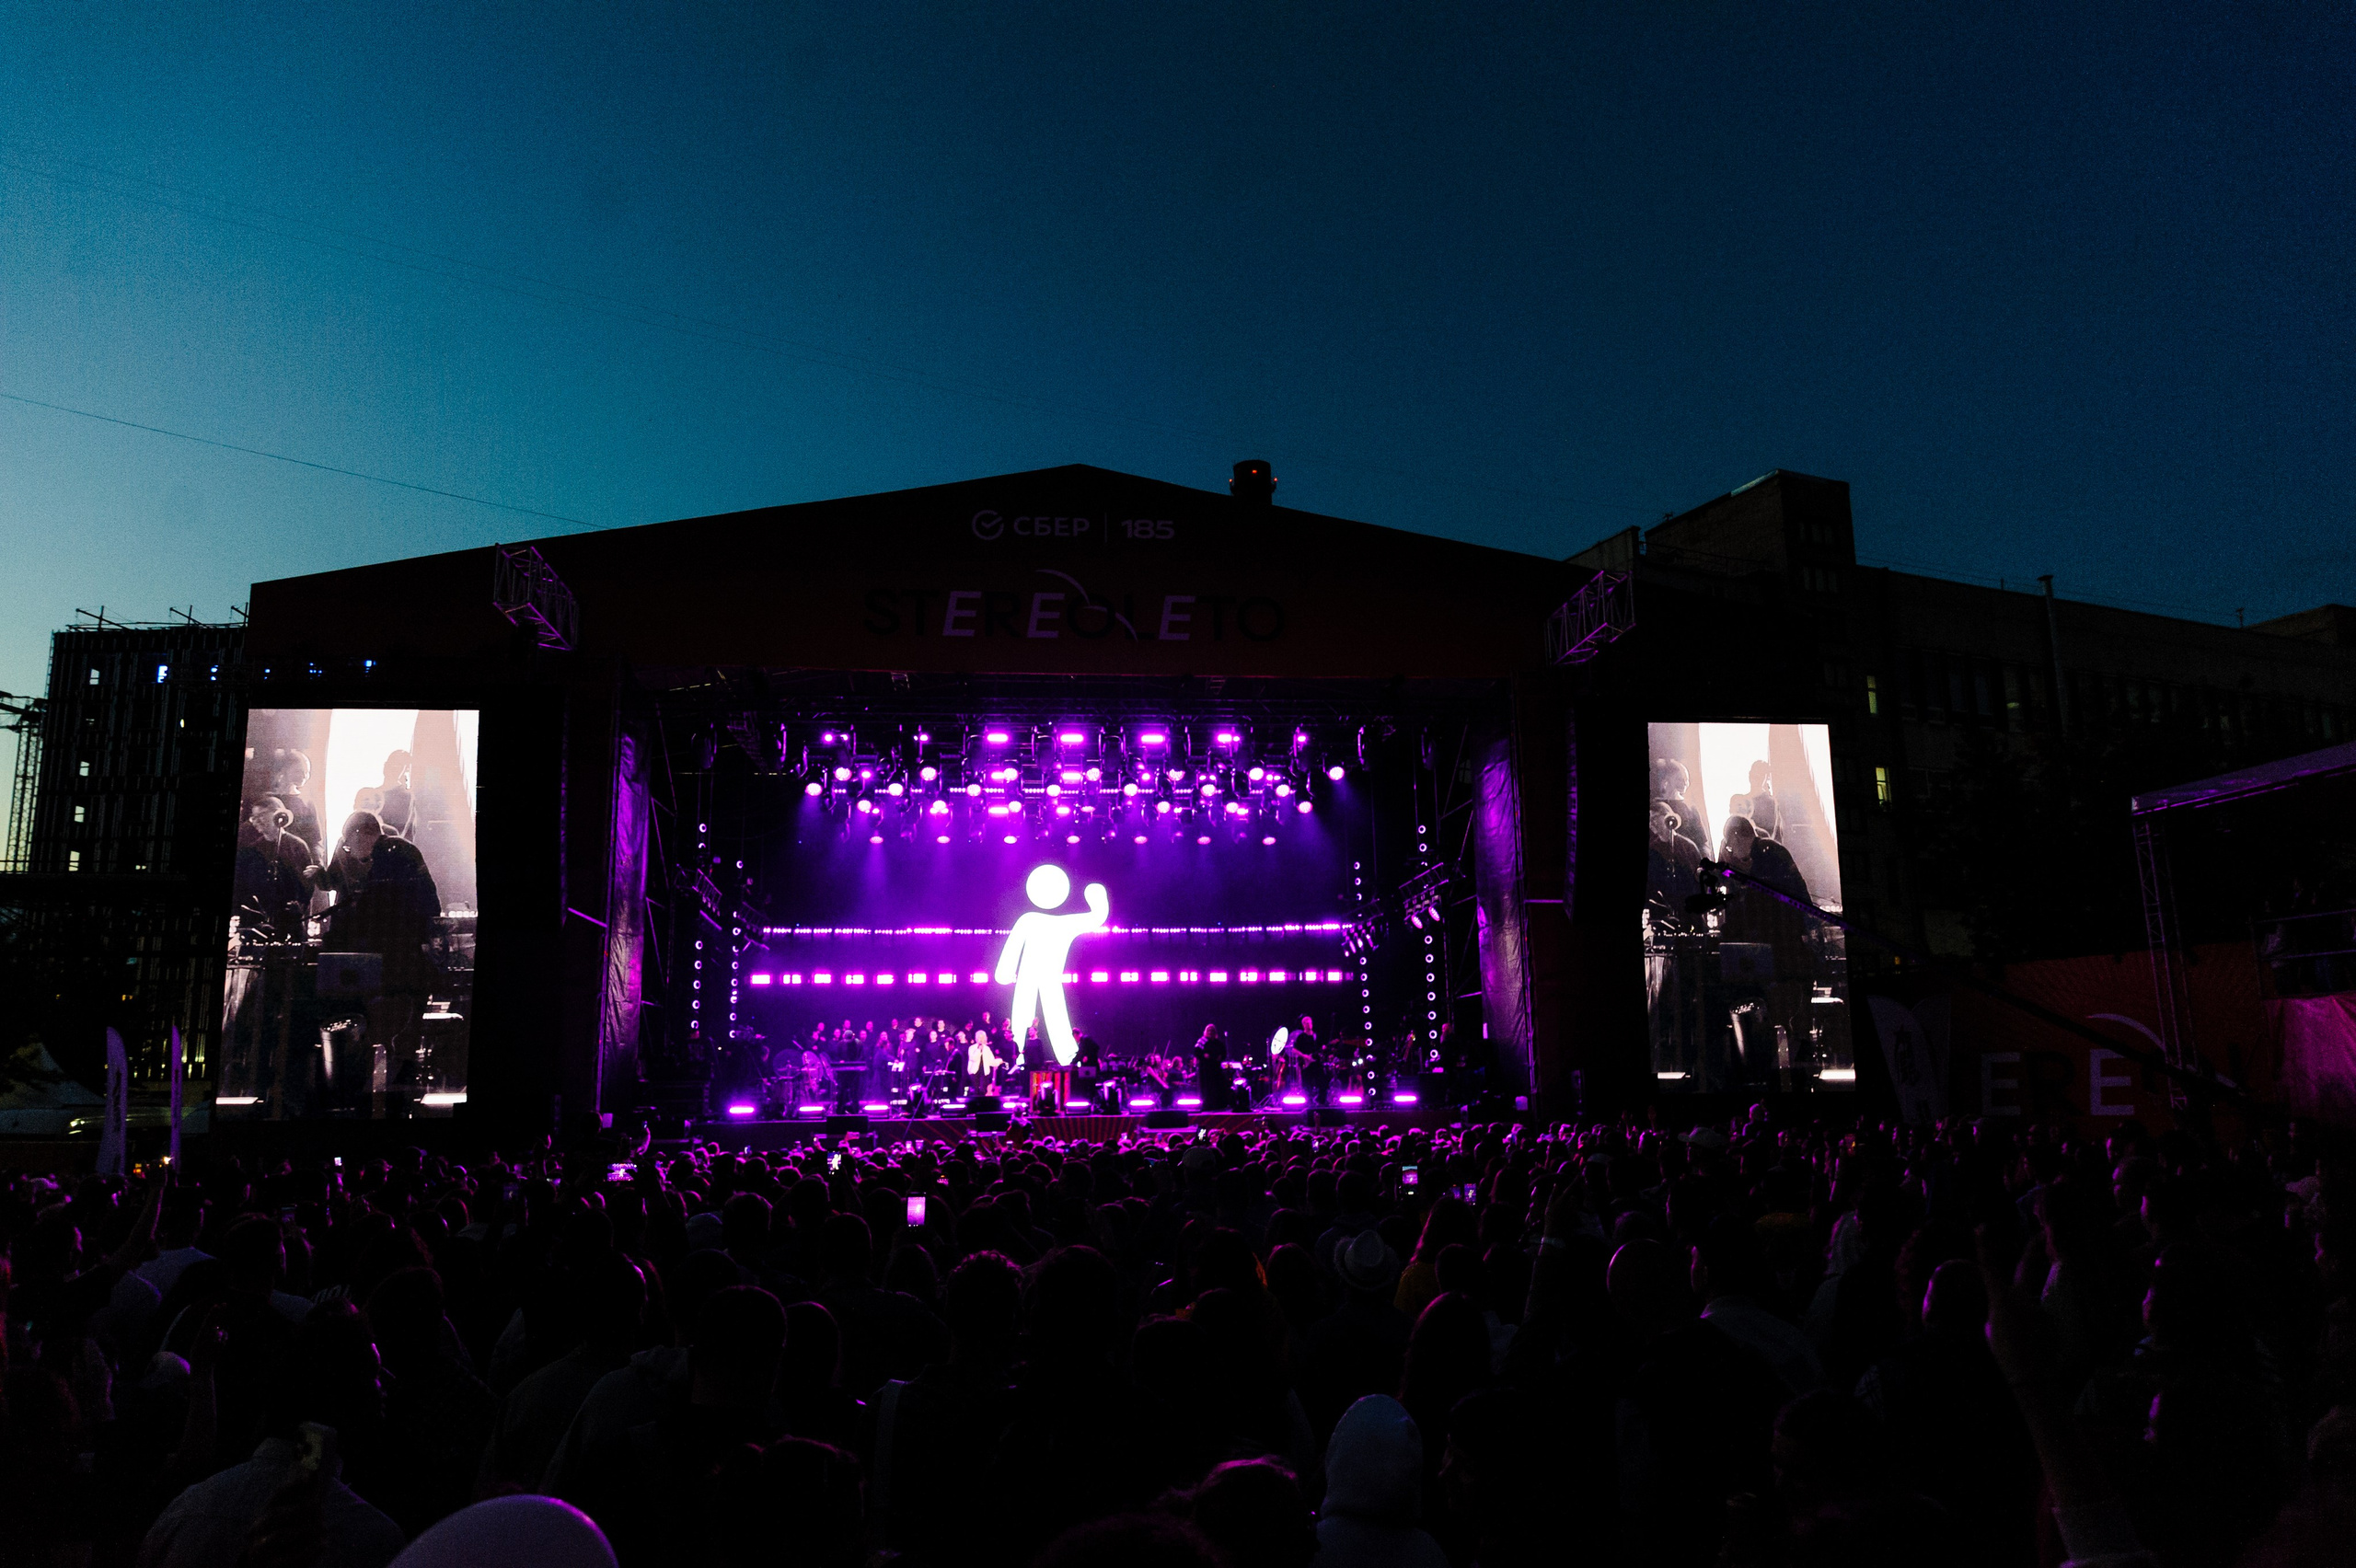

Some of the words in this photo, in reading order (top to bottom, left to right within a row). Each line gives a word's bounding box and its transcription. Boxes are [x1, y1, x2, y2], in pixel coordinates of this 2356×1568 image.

[1013, 516, 1090, 537] СБЕР
[1120, 518, 1176, 540] 185
[863, 588, 1285, 642] STEREOLETO
